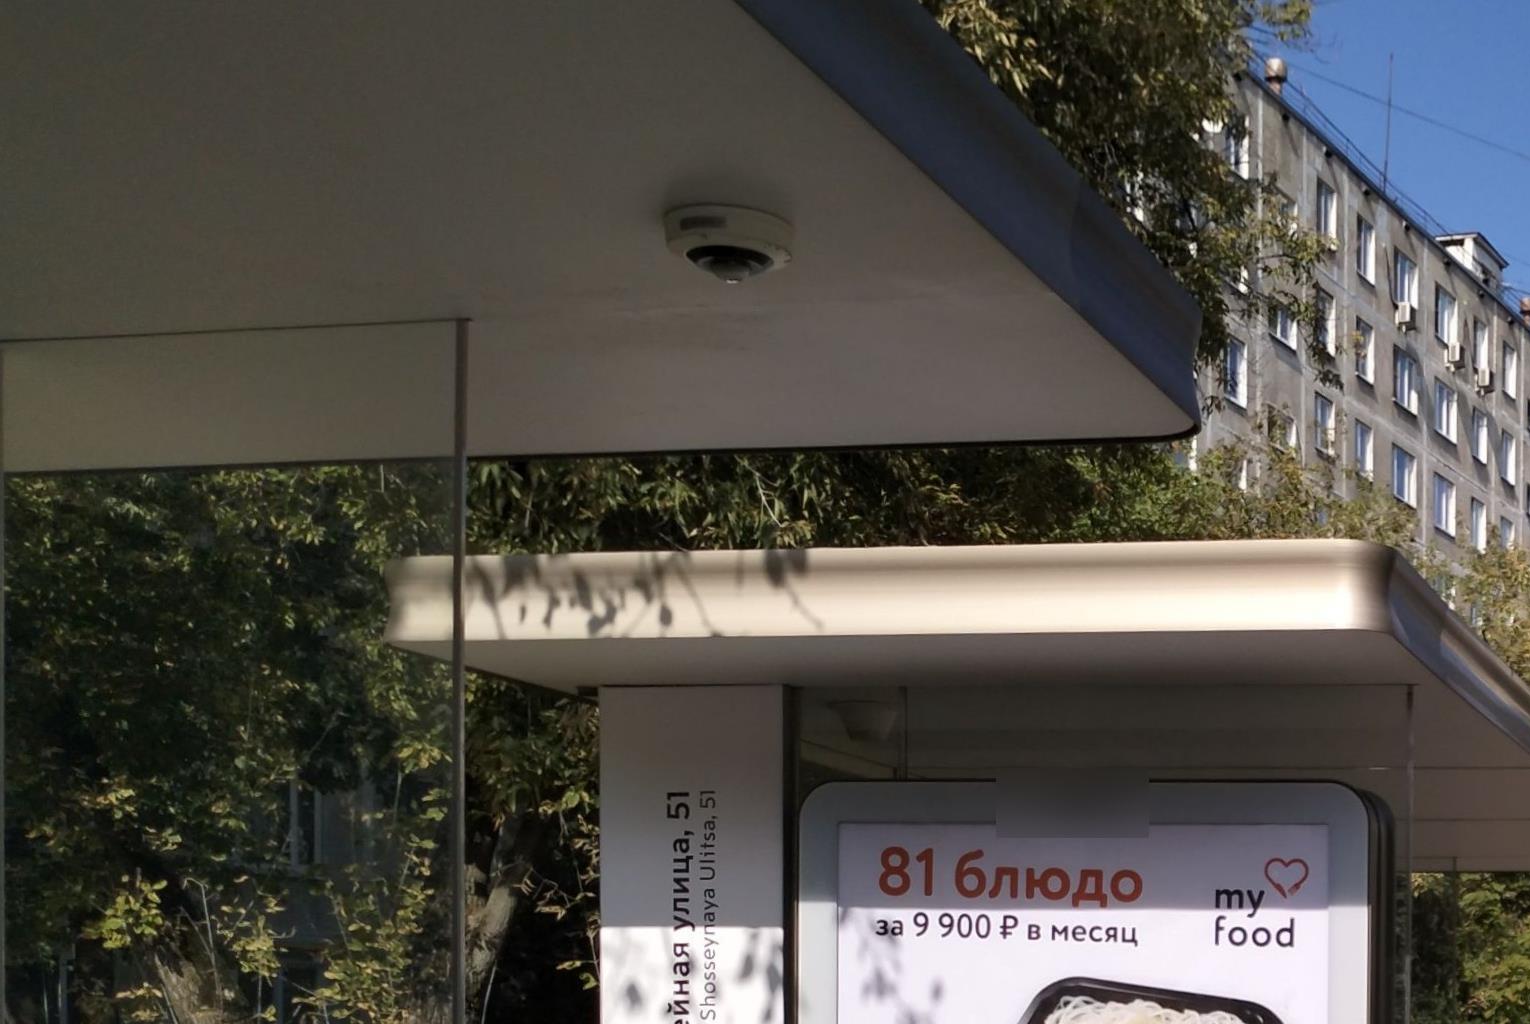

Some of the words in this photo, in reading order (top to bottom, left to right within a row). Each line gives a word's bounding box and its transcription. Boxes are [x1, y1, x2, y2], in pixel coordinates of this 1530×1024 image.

[666, 792, 690, 820] 51
[700, 790, 716, 808] 51
[700, 815, 718, 880] Ulitsa,
[673, 830, 695, 931] улица,
[878, 846, 934, 897] 81
[955, 850, 1143, 908] блюдо
[1215, 889, 1265, 918] my
[875, 919, 903, 936] за
[913, 912, 929, 937] 9
[938, 912, 991, 939] 900
[1000, 915, 1018, 939] ₽
[1027, 923, 1041, 940] в
[1051, 924, 1138, 947] месяц
[1215, 915, 1295, 948] food
[700, 888, 719, 1020] Shosseynaya
